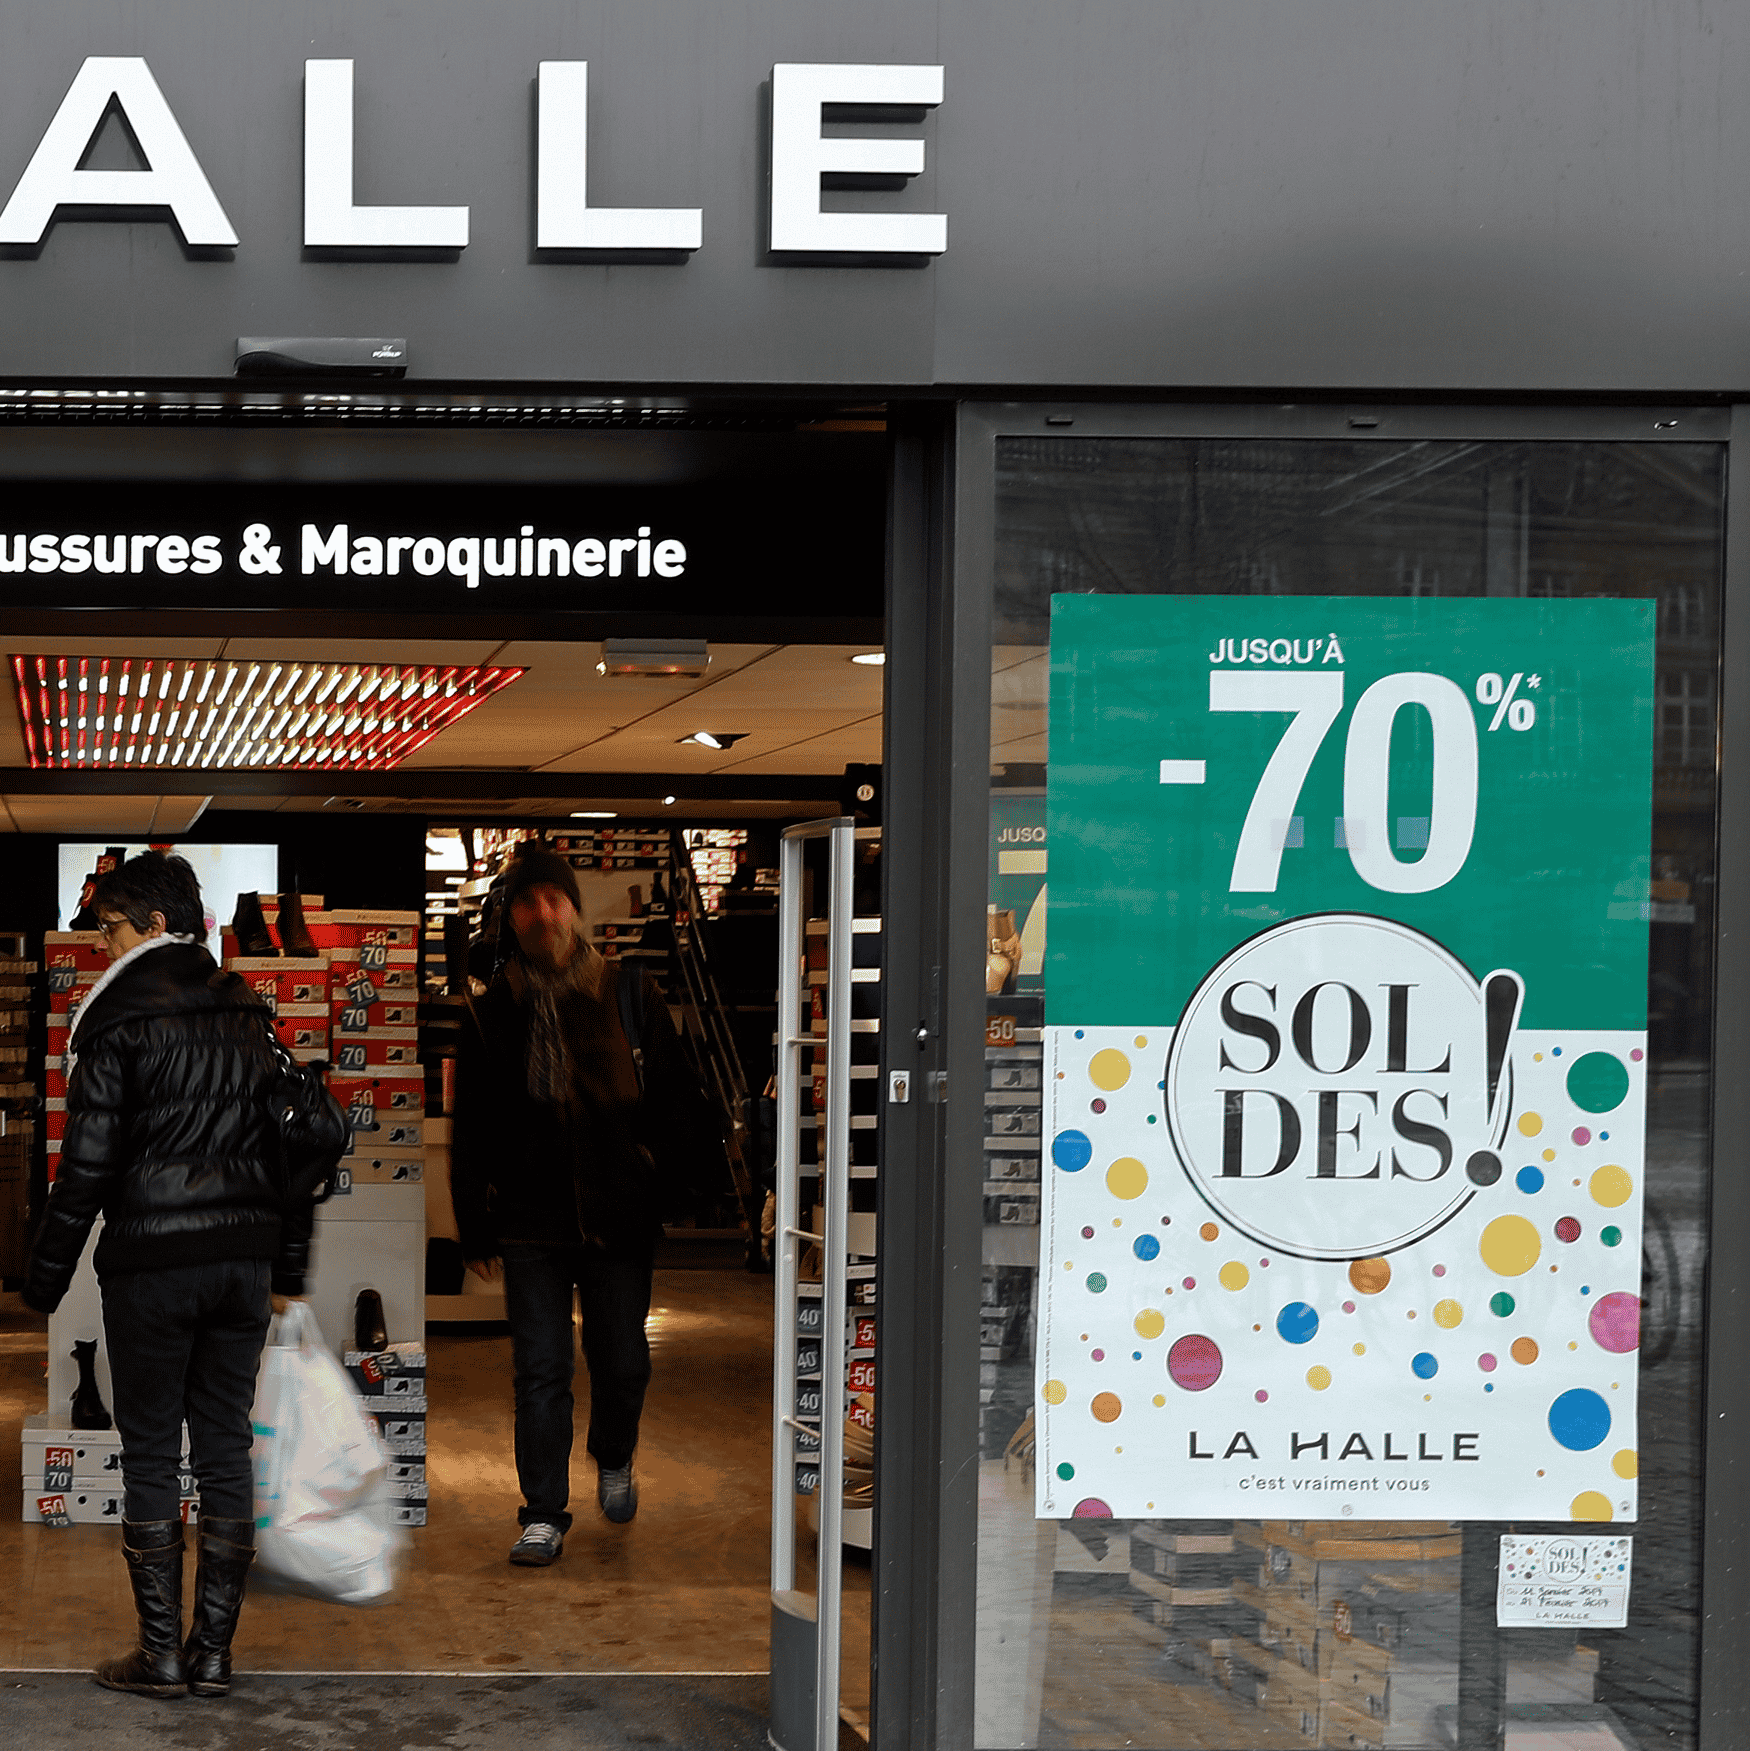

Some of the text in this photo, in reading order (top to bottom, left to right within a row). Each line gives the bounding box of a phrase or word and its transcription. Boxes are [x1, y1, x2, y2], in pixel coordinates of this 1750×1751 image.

[238, 525, 283, 575] &
[300, 524, 687, 588] Maroquinerie
[1209, 633, 1345, 665] JUSQU'À
[998, 826, 1046, 843] JUSQ
[1220, 980, 1451, 1074] SOL
[1189, 1431, 1480, 1461] LA HALLE
[1239, 1475, 1430, 1492] c'est vraiment vous
